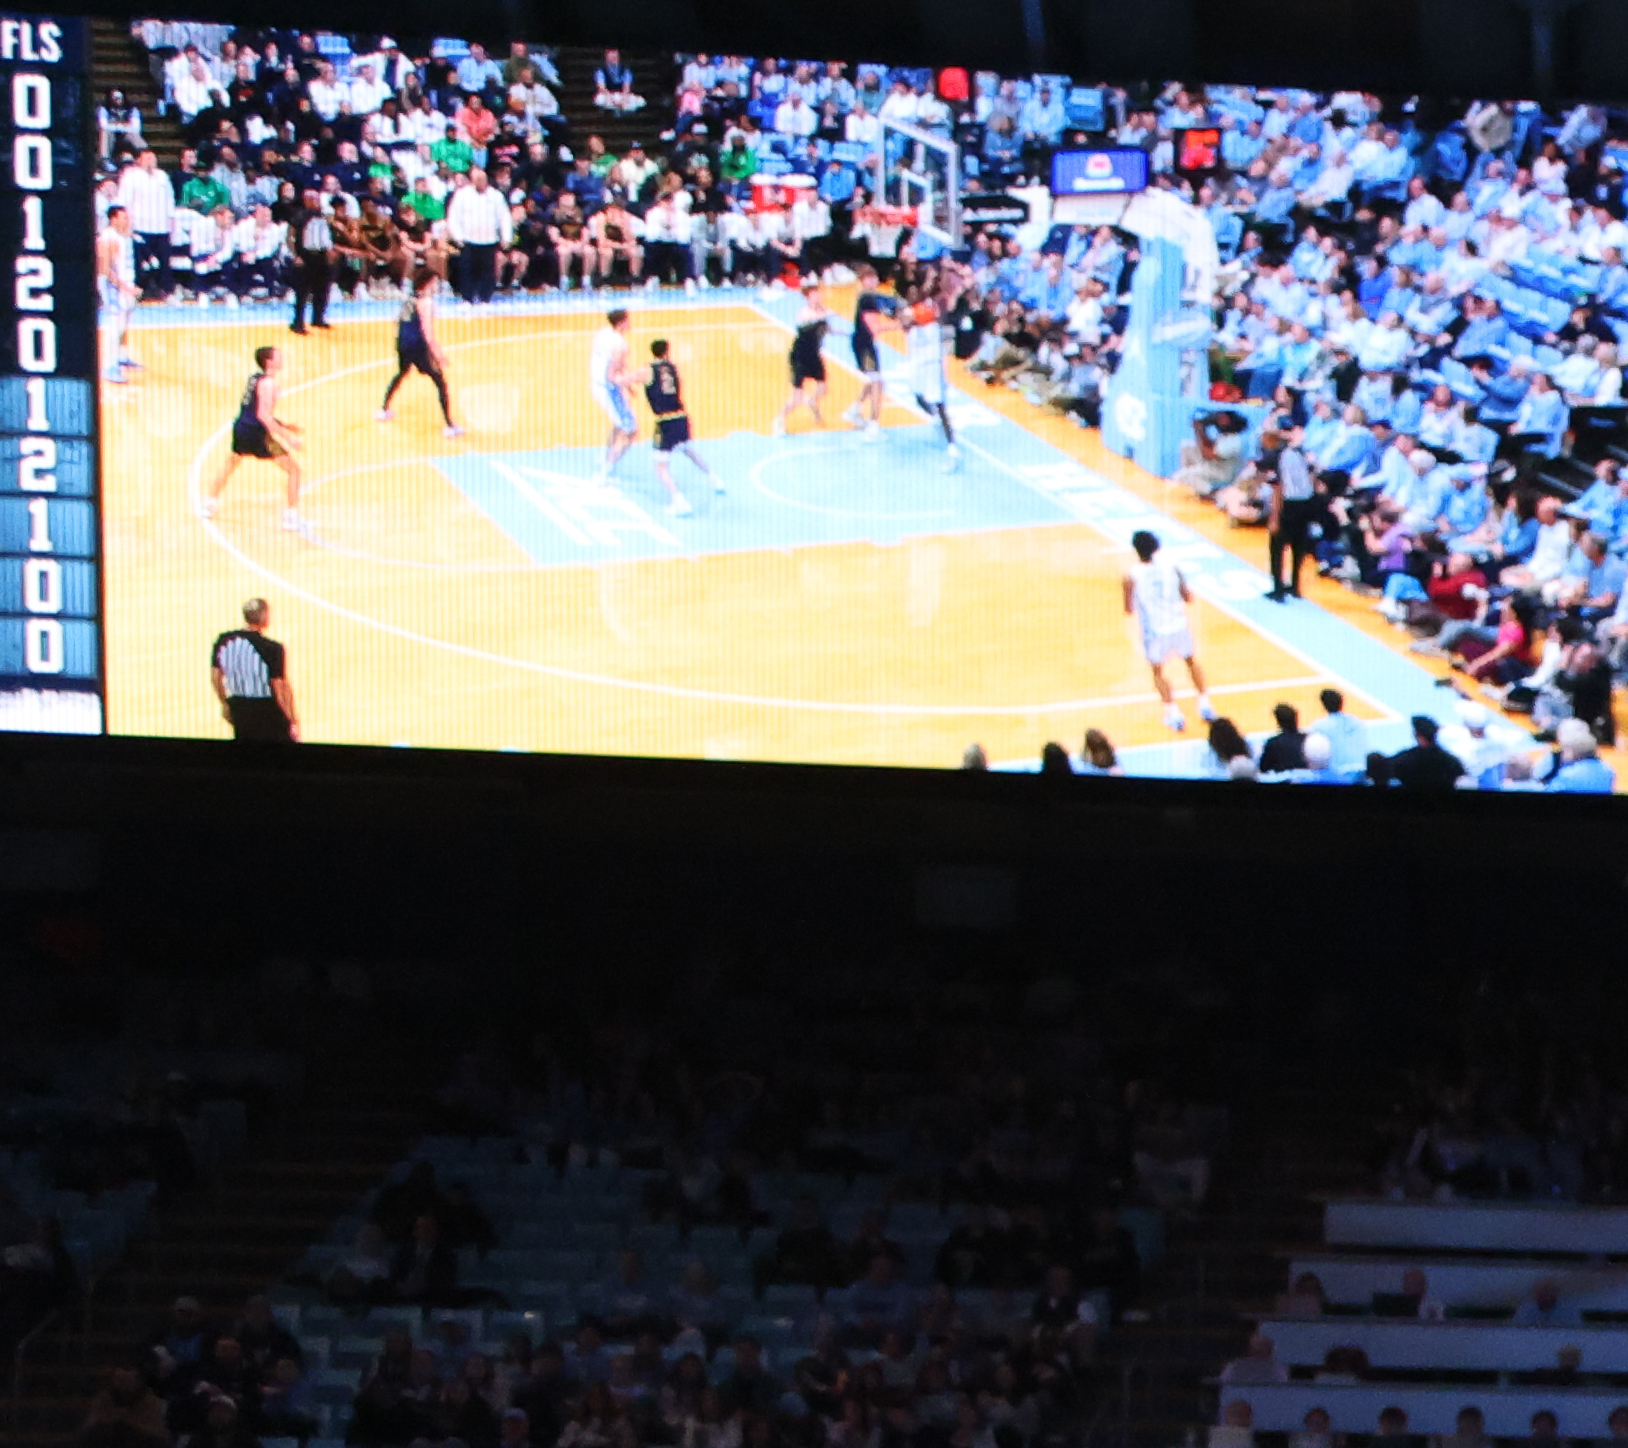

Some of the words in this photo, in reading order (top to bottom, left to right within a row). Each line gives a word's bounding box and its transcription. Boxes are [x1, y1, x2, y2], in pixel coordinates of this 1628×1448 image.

[2, 20, 62, 61] FLS
[14, 74, 51, 130] 0
[14, 135, 53, 191] 0
[22, 197, 45, 251] 1
[15, 257, 54, 313] 2
[17, 319, 55, 373] 0
[26, 380, 48, 431] 1
[20, 440, 56, 492] 2
[28, 500, 54, 552] 1
[24, 560, 62, 613] 0
[26, 620, 63, 674] 0
